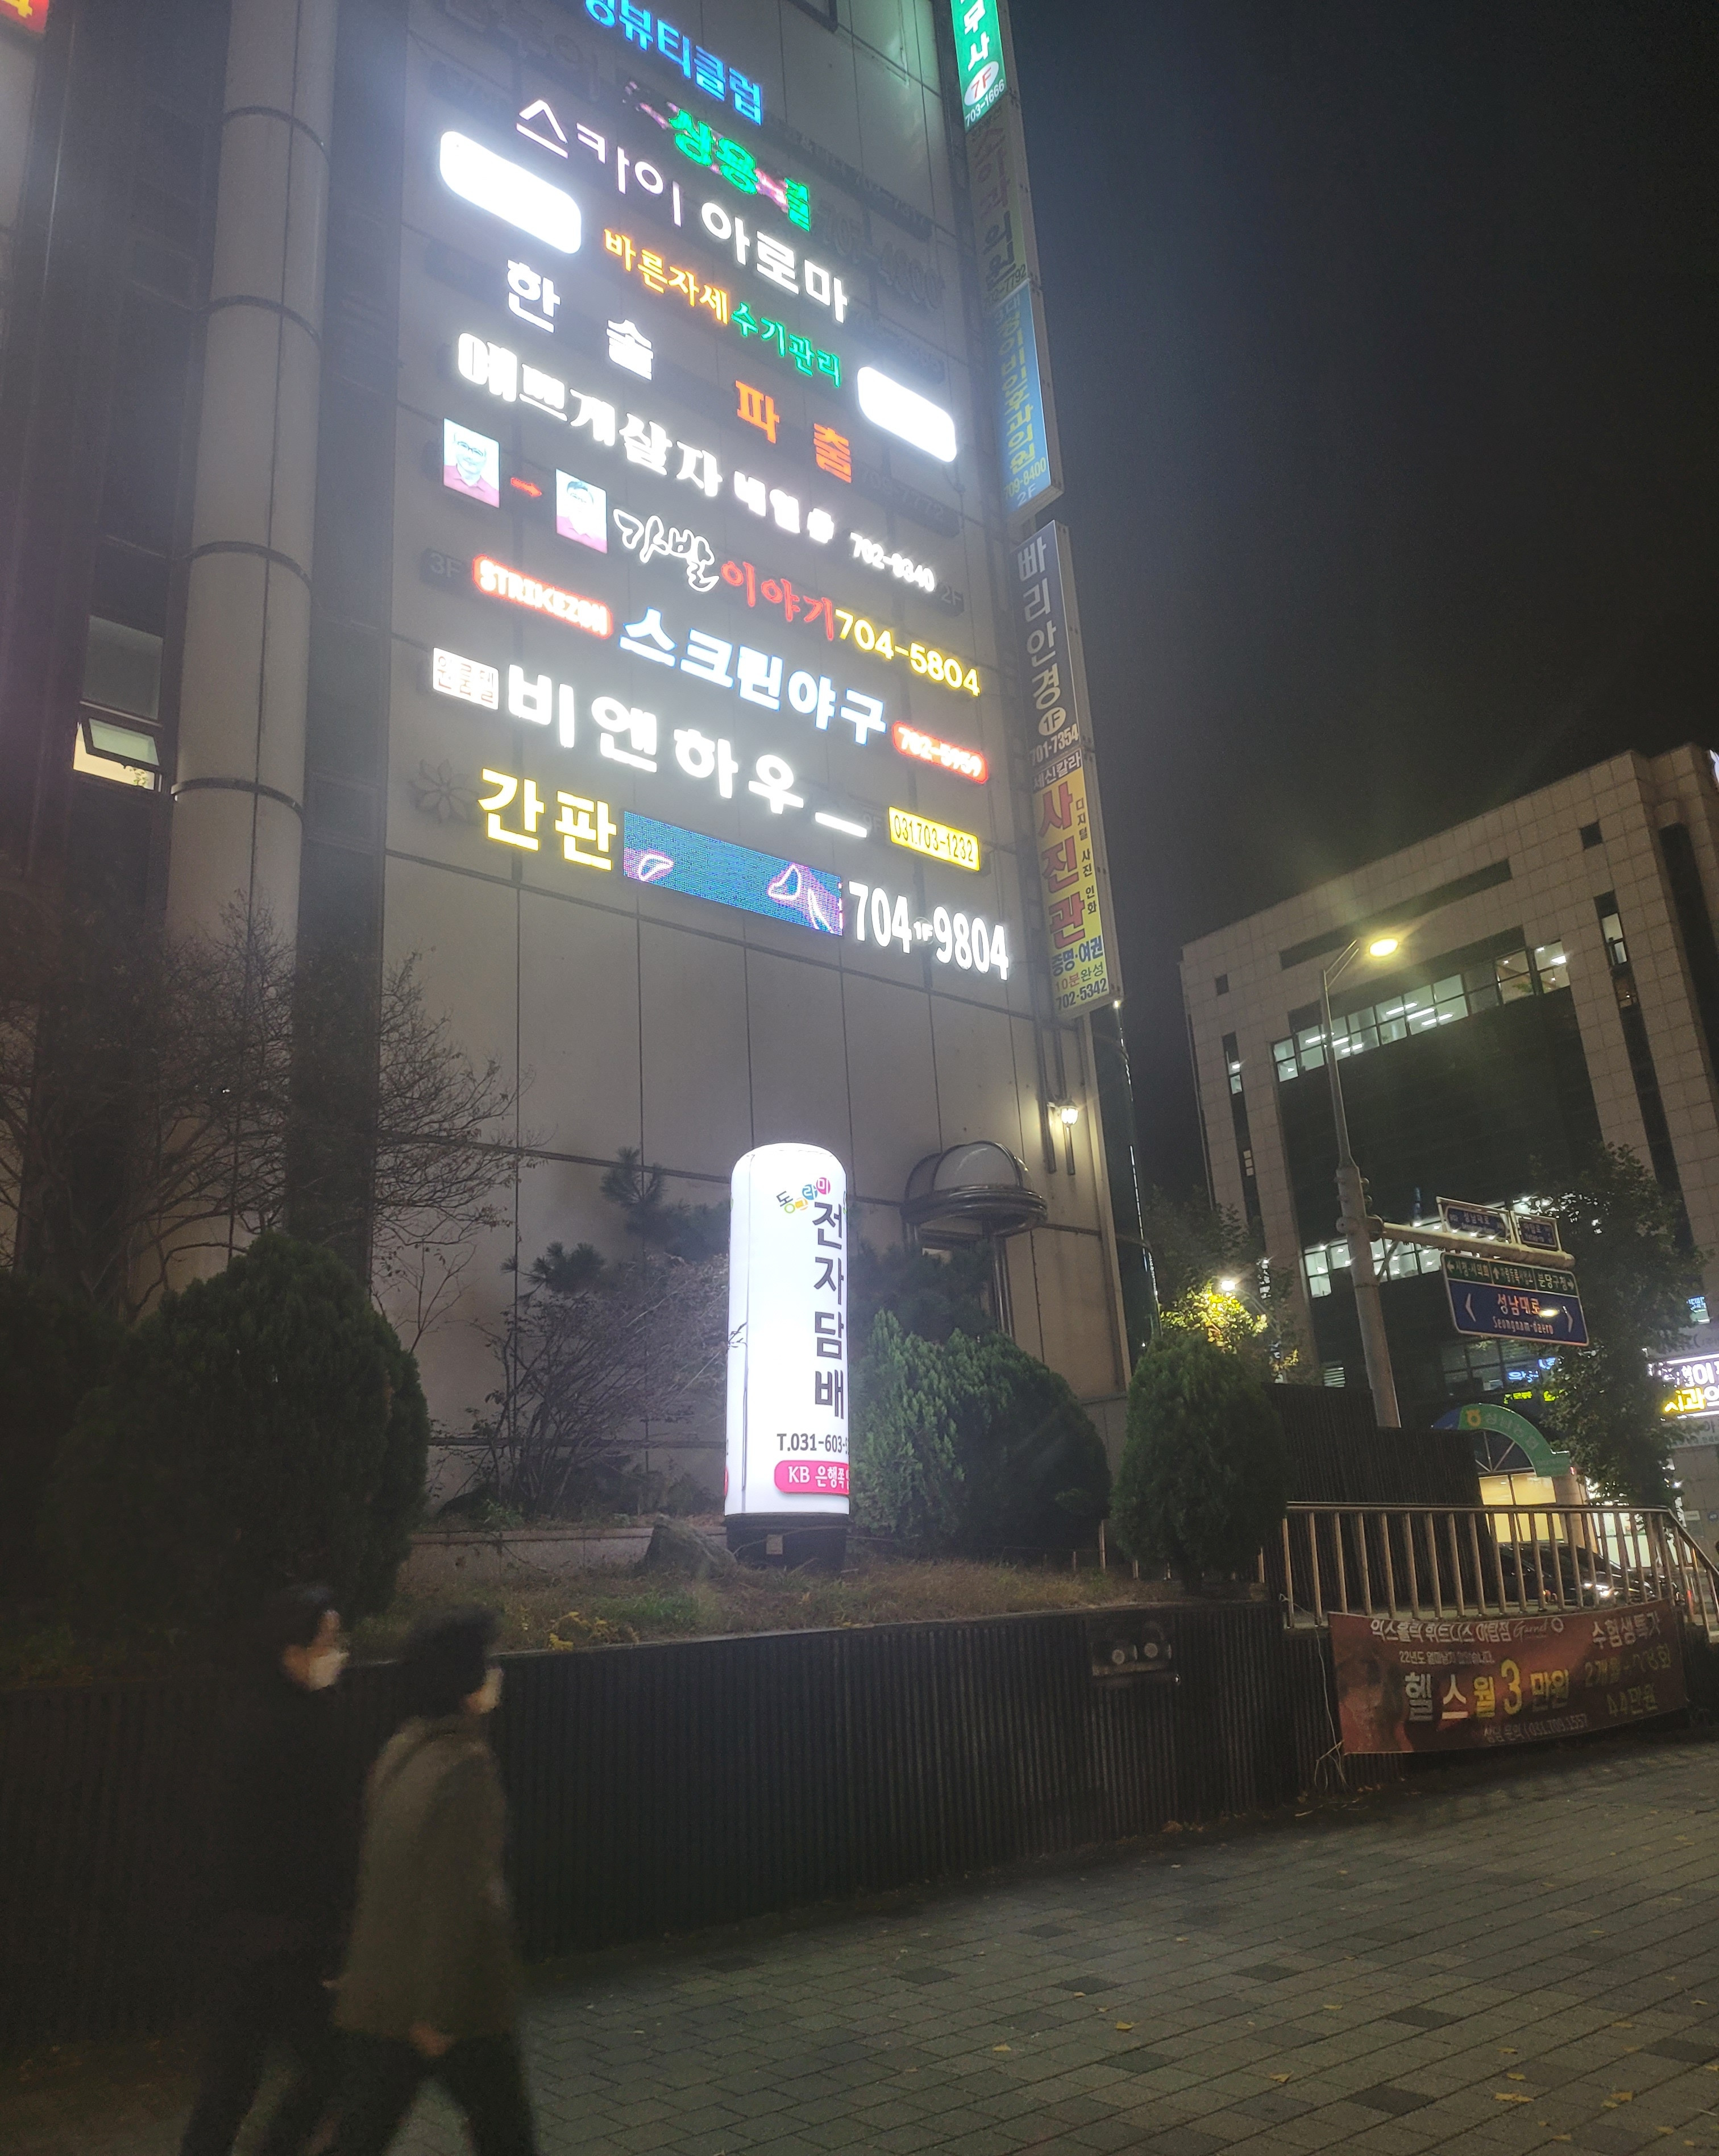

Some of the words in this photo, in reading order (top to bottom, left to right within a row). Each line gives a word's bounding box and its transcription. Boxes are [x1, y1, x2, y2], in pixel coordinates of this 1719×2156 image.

[961, 0, 991, 72] 무사
[965, 78, 1005, 127] 703-1666
[970, 67, 993, 99] 7F
[516, 99, 683, 227] 스카이
[700, 202, 848, 324] 아로마
[603, 229, 729, 325] 바른자세
[731, 301, 841, 388] 수기관리
[1003, 457, 1047, 500] 709-8400
[1016, 482, 1037, 508] 2F
[720, 560, 835, 642] 이야기
[834, 608, 982, 698] 704-5804
[1017, 536, 1061, 710] 빠리안경
[618, 606, 887, 746] 스크린야구
[1029, 723, 1079, 766] 701-7354
[477, 768, 618, 871] 간판
[894, 815, 974, 863] 031.703-1232
[1075, 798, 1089, 841] 디지털
[1038, 780, 1086, 950] 사진관
[1082, 848, 1093, 877] 사진
[1085, 885, 1097, 915] 인화
[812, 1201, 844, 1420] 전자담배
[1497, 1293, 1541, 1316] 성남대로
[788, 1465, 811, 1484] KB
